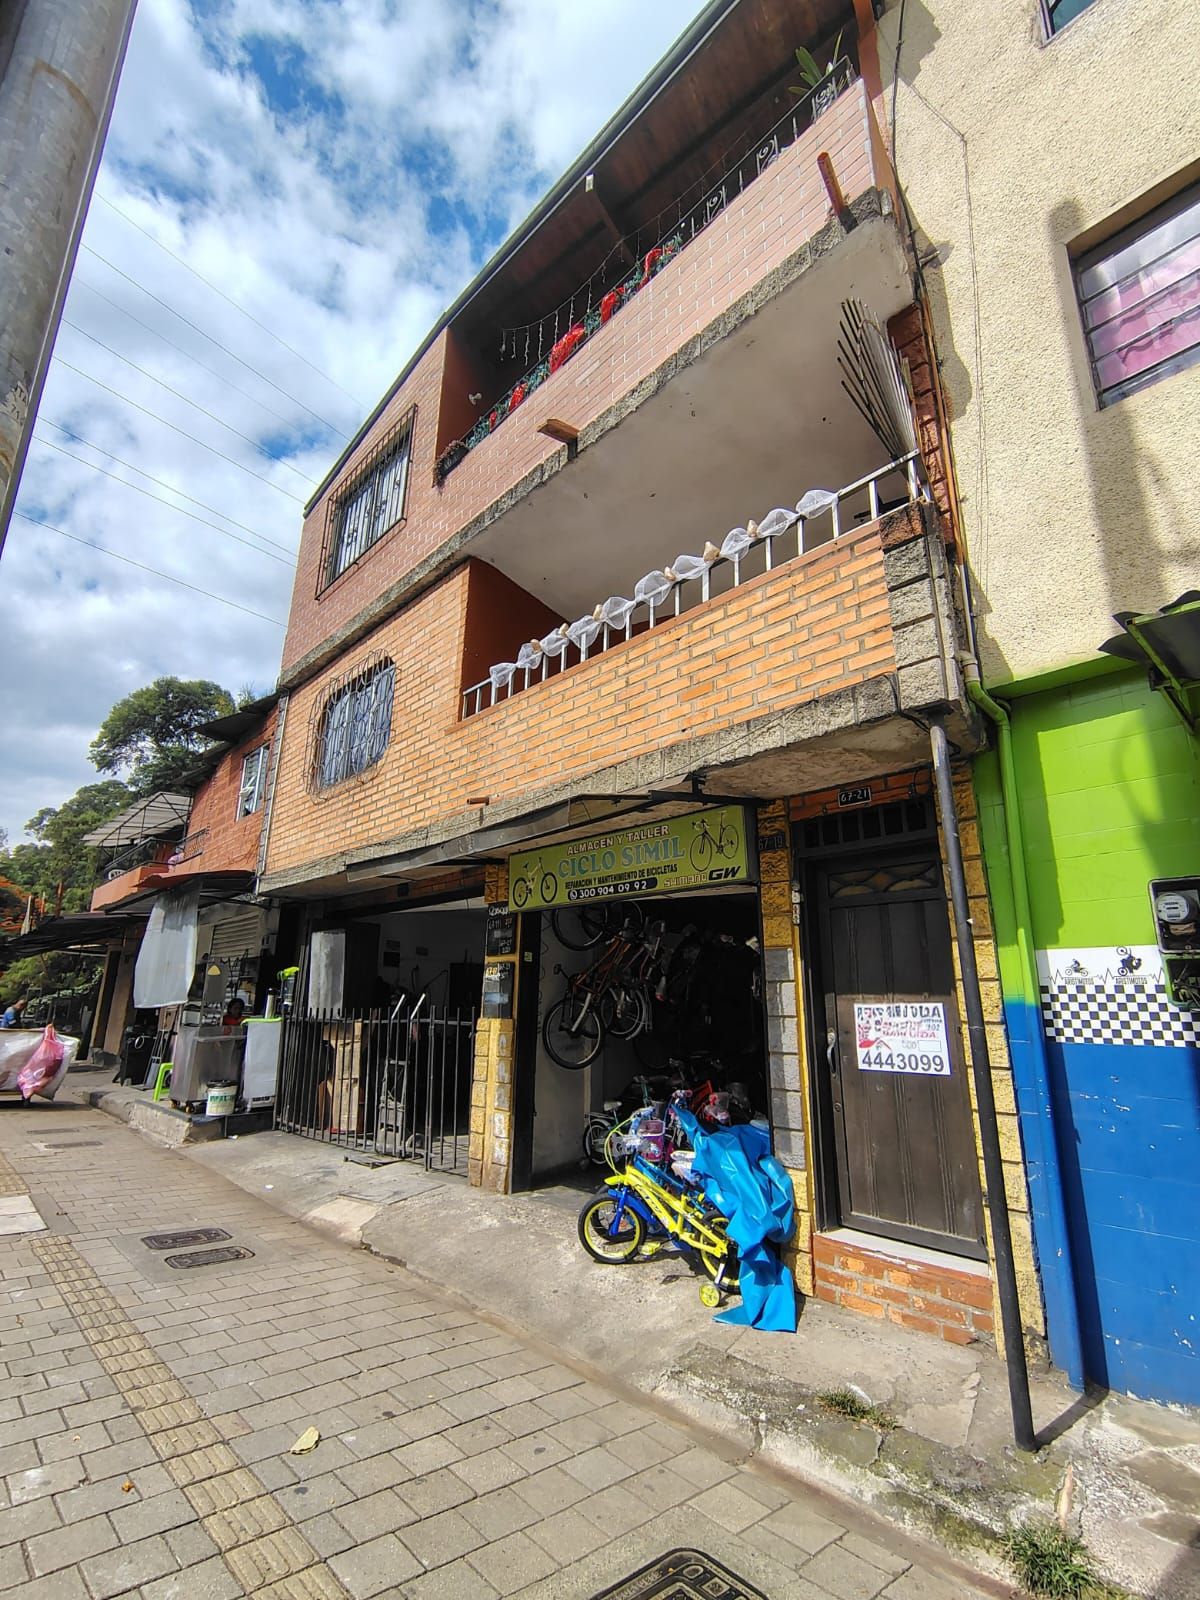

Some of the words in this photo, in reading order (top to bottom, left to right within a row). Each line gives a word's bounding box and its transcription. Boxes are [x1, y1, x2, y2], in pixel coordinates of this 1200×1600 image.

[841, 789, 867, 802] 67-21
[567, 837, 614, 856] ALMACEN
[616, 834, 625, 845] Y
[626, 825, 670, 843] TALLER
[558, 850, 616, 878] CICLO
[621, 836, 686, 867] SIMIL
[638, 869, 645, 877] DE
[646, 863, 678, 876] BICICLETAS
[708, 866, 741, 880] GW
[579, 888, 596, 898] 300
[597, 885, 614, 895] 904
[618, 883, 630, 892] 09
[862, 1050, 945, 1072] 4443099
